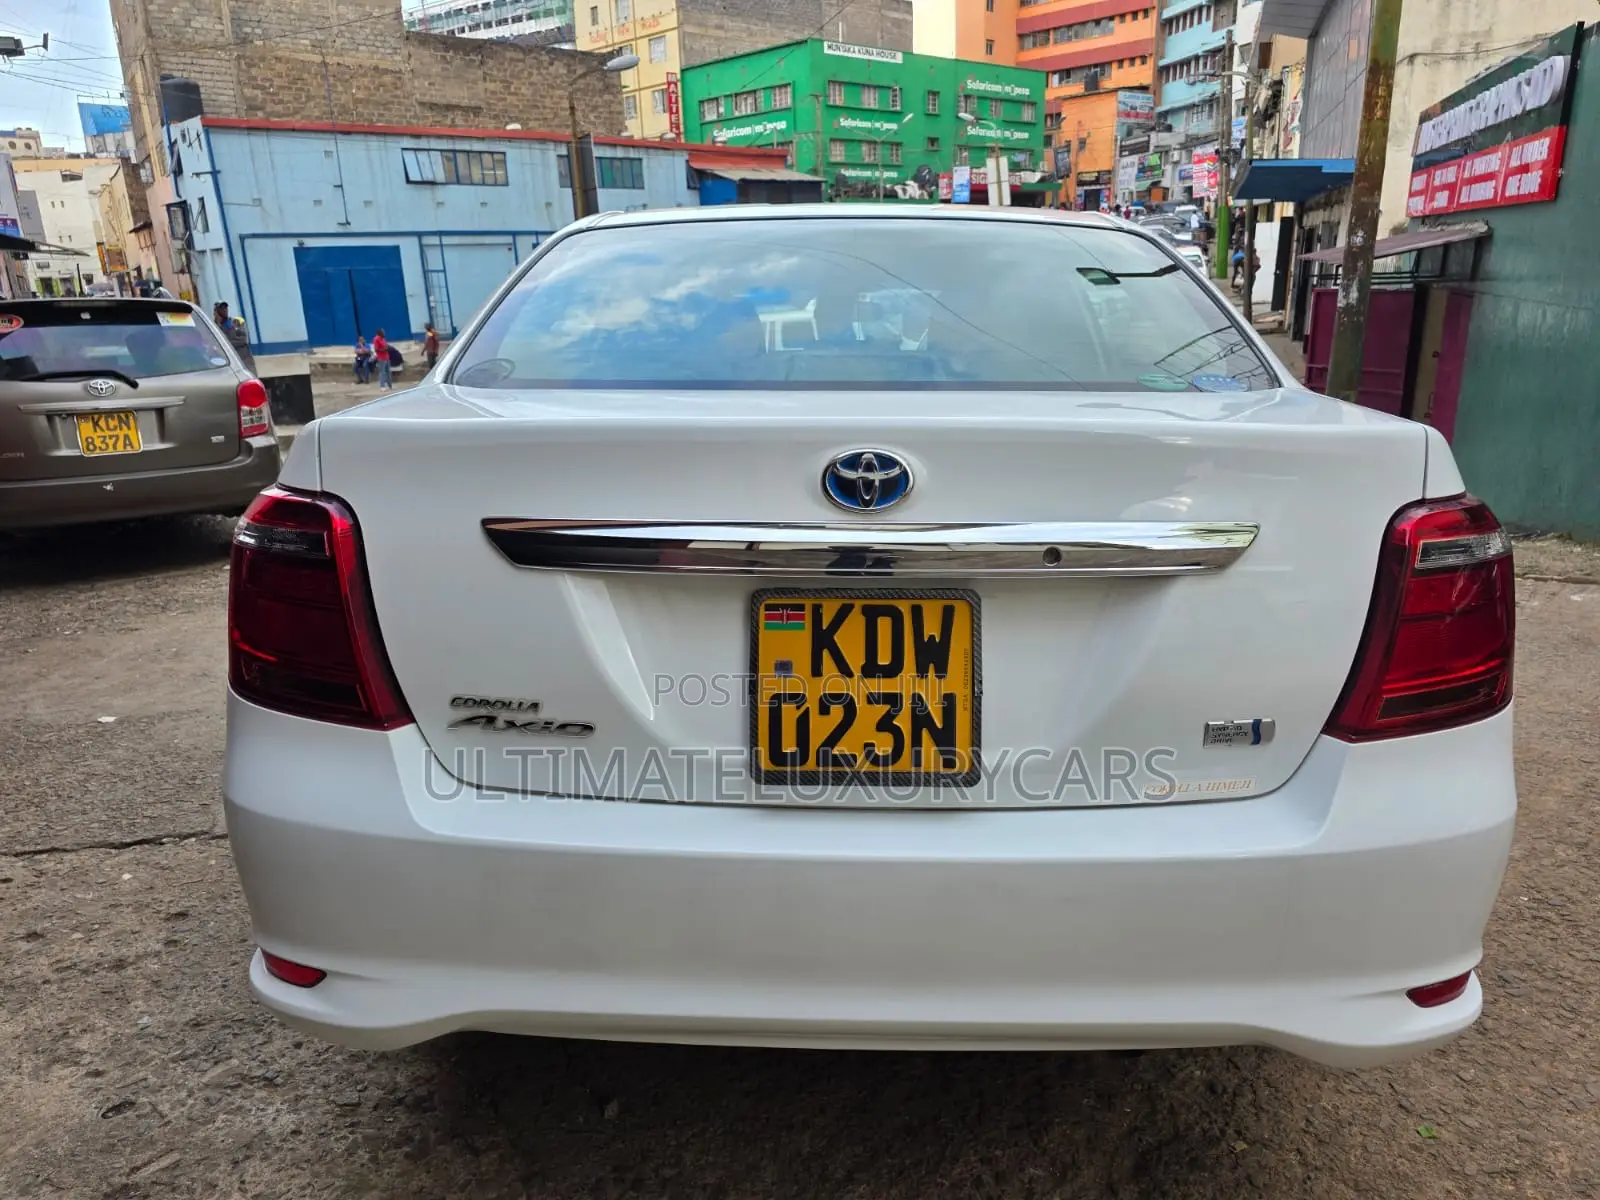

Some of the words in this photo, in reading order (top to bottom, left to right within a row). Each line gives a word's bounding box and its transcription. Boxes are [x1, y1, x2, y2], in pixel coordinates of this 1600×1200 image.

[875, 49, 897, 60] HOUSE
[967, 80, 1002, 92] Safaricom
[839, 117, 871, 129] Safaricom
[713, 127, 752, 141] Safaricom
[91, 414, 132, 432] KCN
[85, 433, 134, 452] 837A
[810, 603, 956, 679] KDW
[450, 696, 541, 712] COROLLA
[768, 691, 957, 769] 023N
